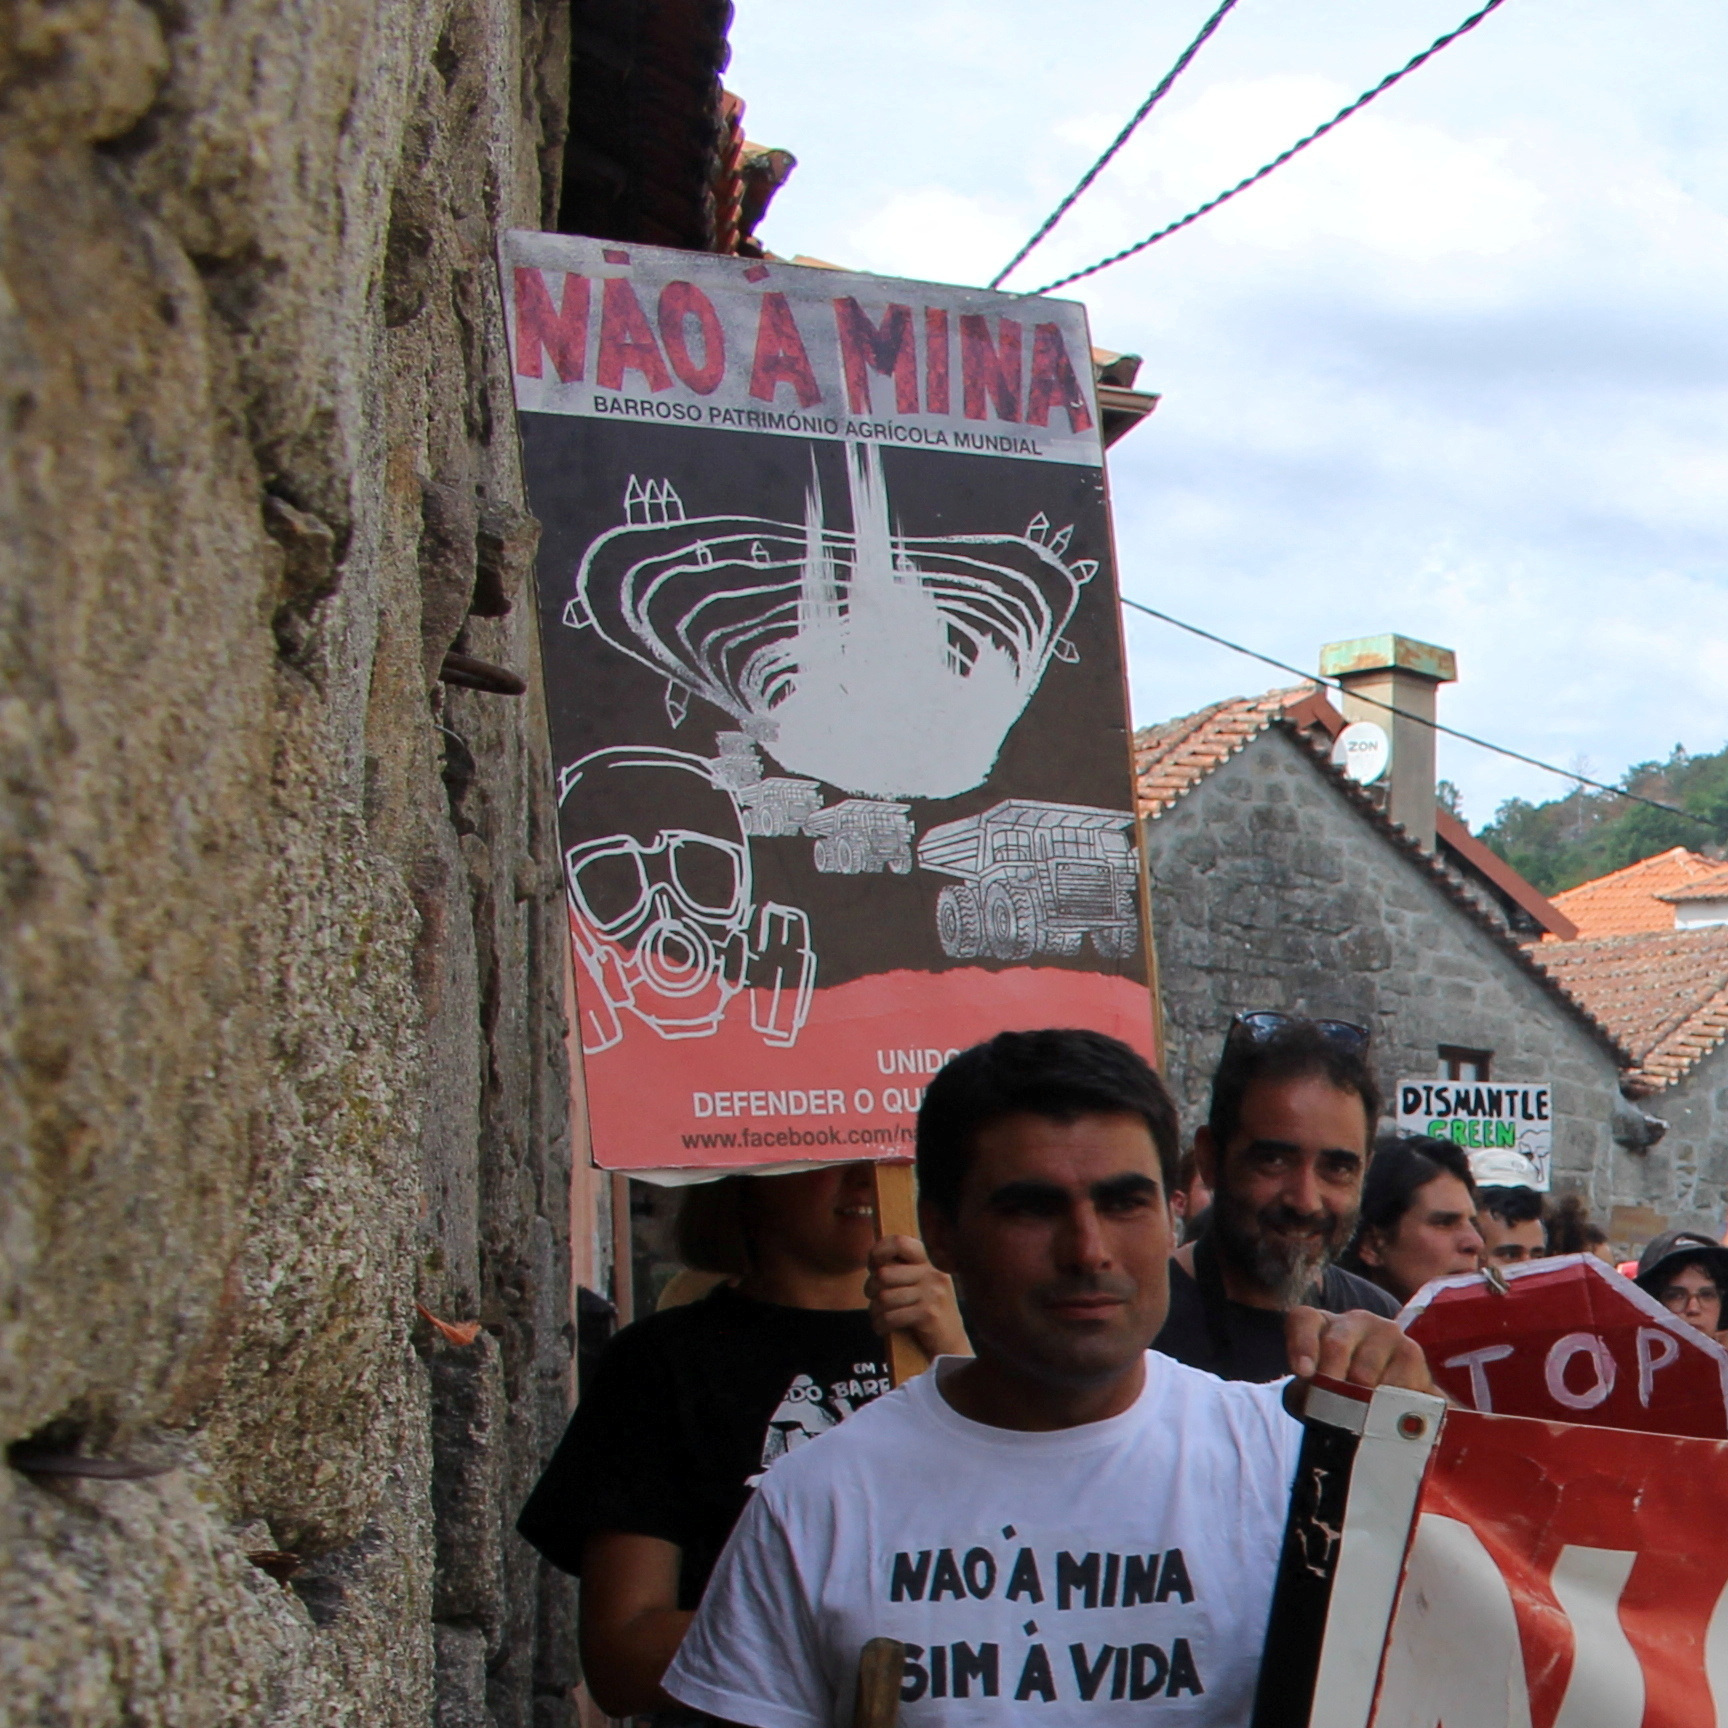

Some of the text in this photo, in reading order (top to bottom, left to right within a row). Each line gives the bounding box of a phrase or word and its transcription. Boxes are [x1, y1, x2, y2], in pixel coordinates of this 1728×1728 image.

[832, 296, 1096, 434] MINA
[594, 395, 1043, 456] BARROSO PATRIMÓNIO AGRÍCOLA MUNDIAL
[693, 1086, 928, 1118] DEFENDER O QU
[1402, 1085, 1549, 1121] DISMANTLE
[1427, 1117, 1516, 1149] GREEN
[1056, 1548, 1197, 1611] MINA
[900, 1640, 1000, 1703] SIM
[1068, 1637, 1205, 1702] VIDA
